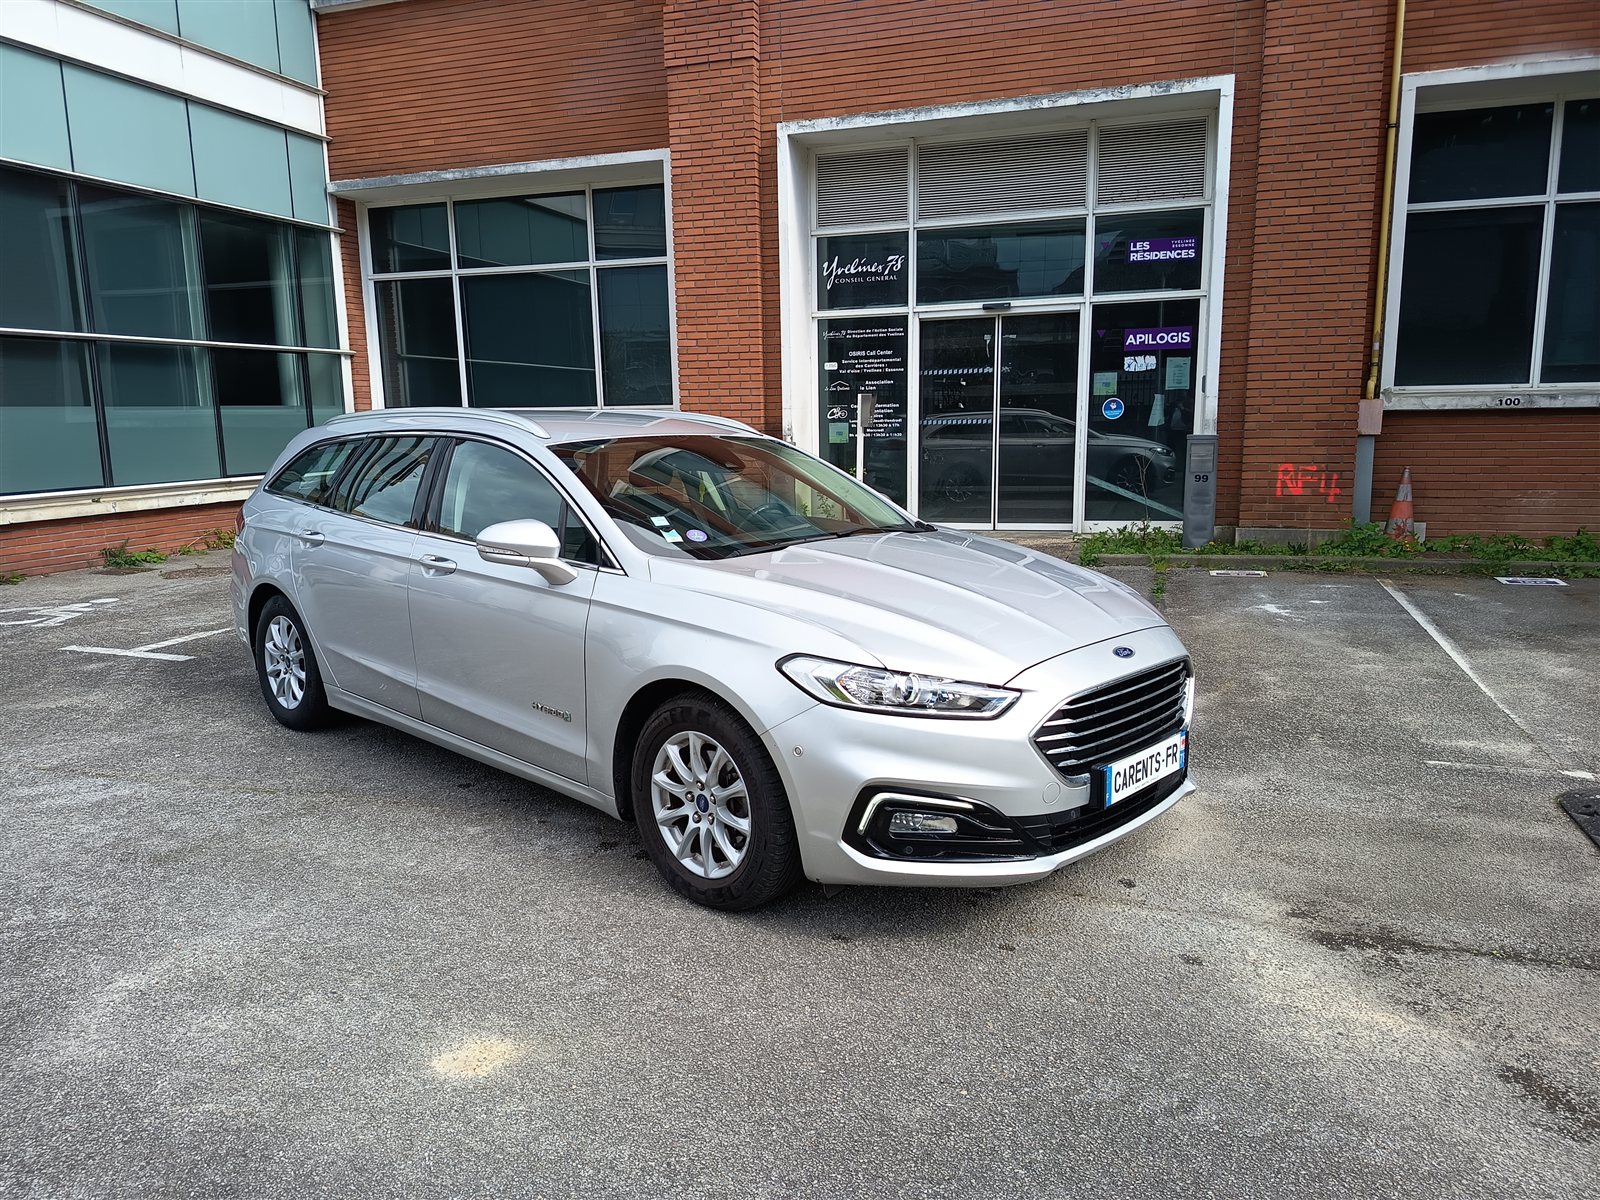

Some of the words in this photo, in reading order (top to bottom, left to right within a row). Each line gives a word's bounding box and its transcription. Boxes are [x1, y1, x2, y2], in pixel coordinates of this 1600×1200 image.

[1130, 241, 1150, 251] LES
[1130, 249, 1195, 262] RÉSIDENCES
[884, 255, 905, 275] 78
[1125, 332, 1191, 345] APILOGIS
[1498, 398, 1520, 406] 100
[1194, 474, 1209, 483] 99
[532, 702, 565, 719] HYBRID
[1114, 743, 1178, 793] CARENTS-FR
